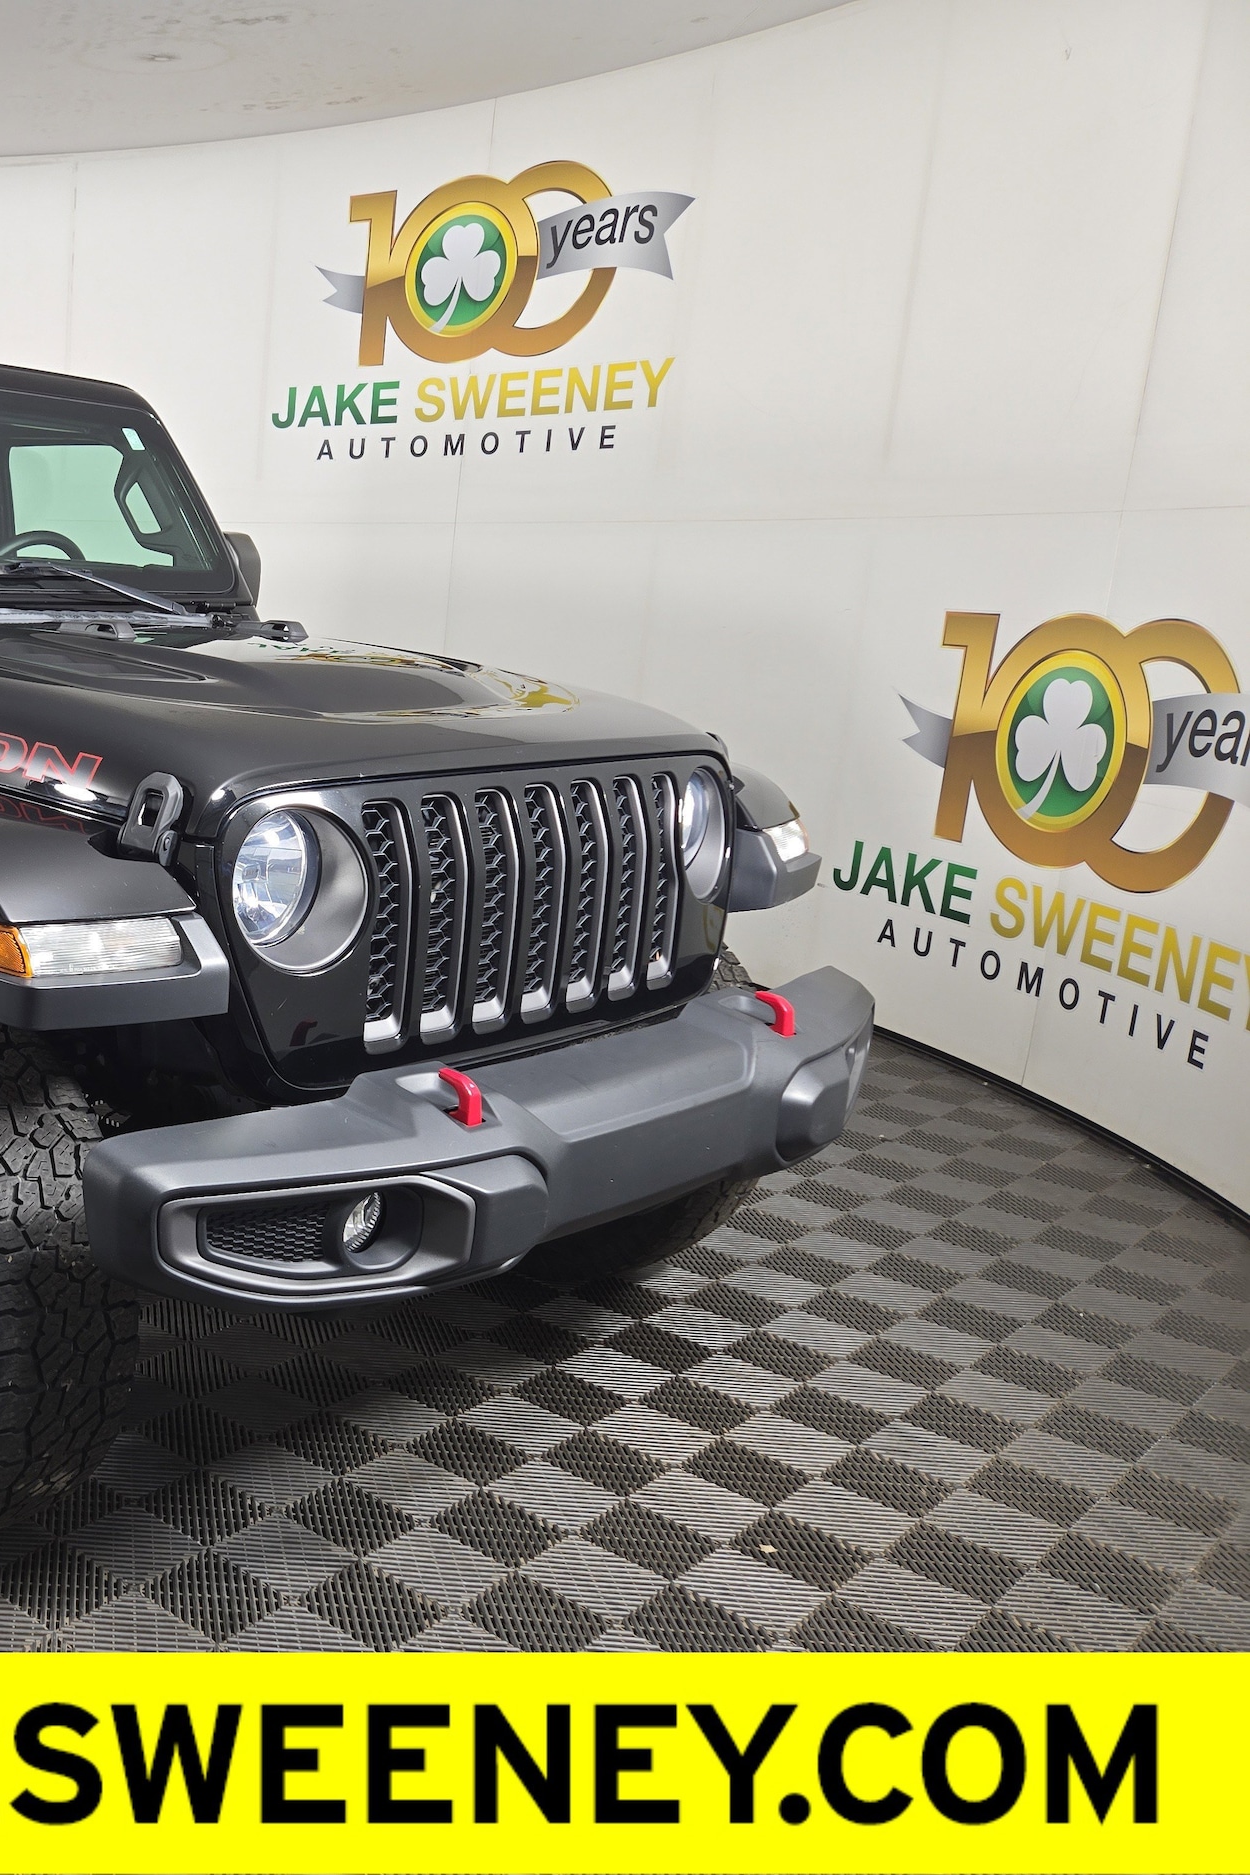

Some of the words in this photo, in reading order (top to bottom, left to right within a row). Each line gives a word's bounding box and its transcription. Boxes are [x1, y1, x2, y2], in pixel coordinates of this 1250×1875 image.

[546, 202, 658, 269] years
[271, 380, 400, 428] JAKE
[414, 357, 676, 423] SWEENEY
[316, 425, 617, 460] AUTOMOTIVE
[1155, 708, 1250, 773] yea
[833, 840, 978, 925] JAKE
[990, 877, 1250, 1032] SWEENE
[877, 919, 1210, 1070] AUTOMOTIVE
